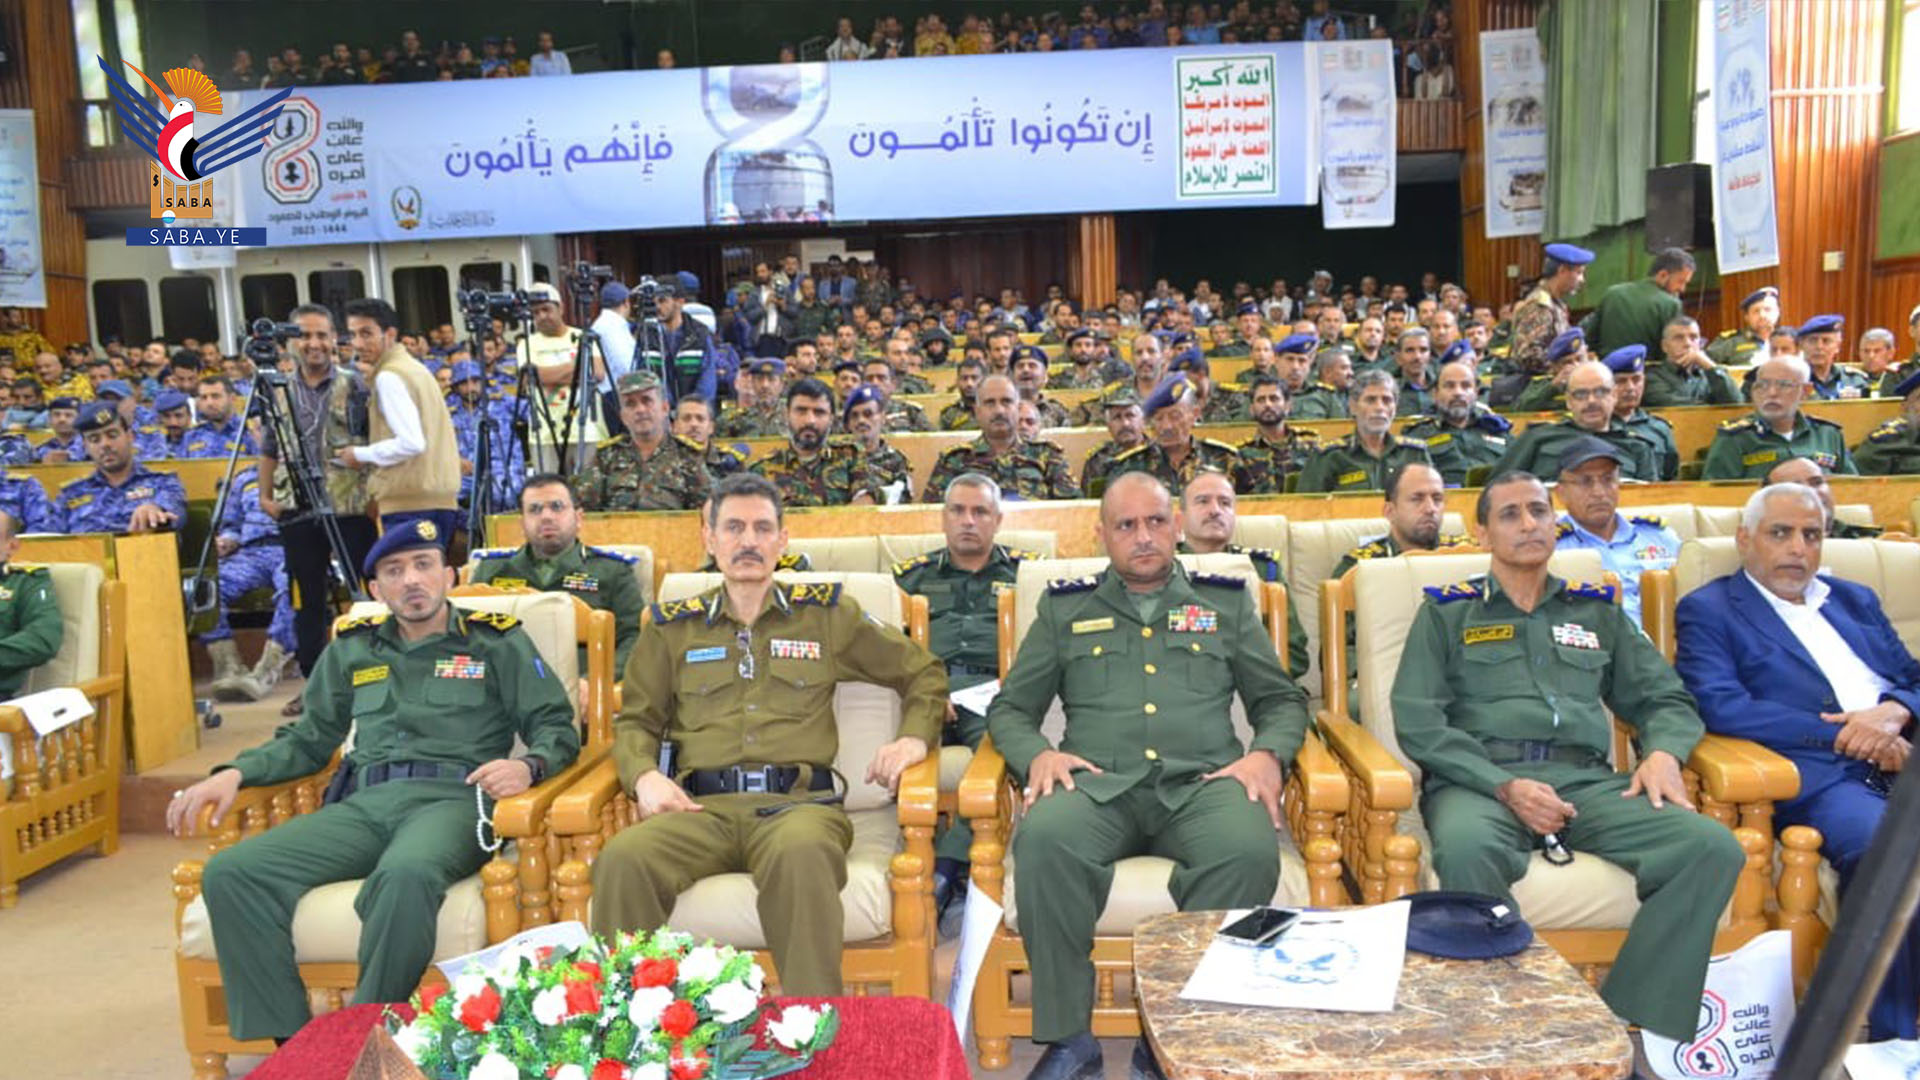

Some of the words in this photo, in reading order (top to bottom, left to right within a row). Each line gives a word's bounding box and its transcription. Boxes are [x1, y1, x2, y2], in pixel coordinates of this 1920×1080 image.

[1184, 61, 1234, 93] أكبر
[1237, 64, 1269, 85] الله
[1233, 93, 1270, 112] الموت
[1233, 116, 1270, 136] الموت
[1232, 161, 1270, 188] النصر
